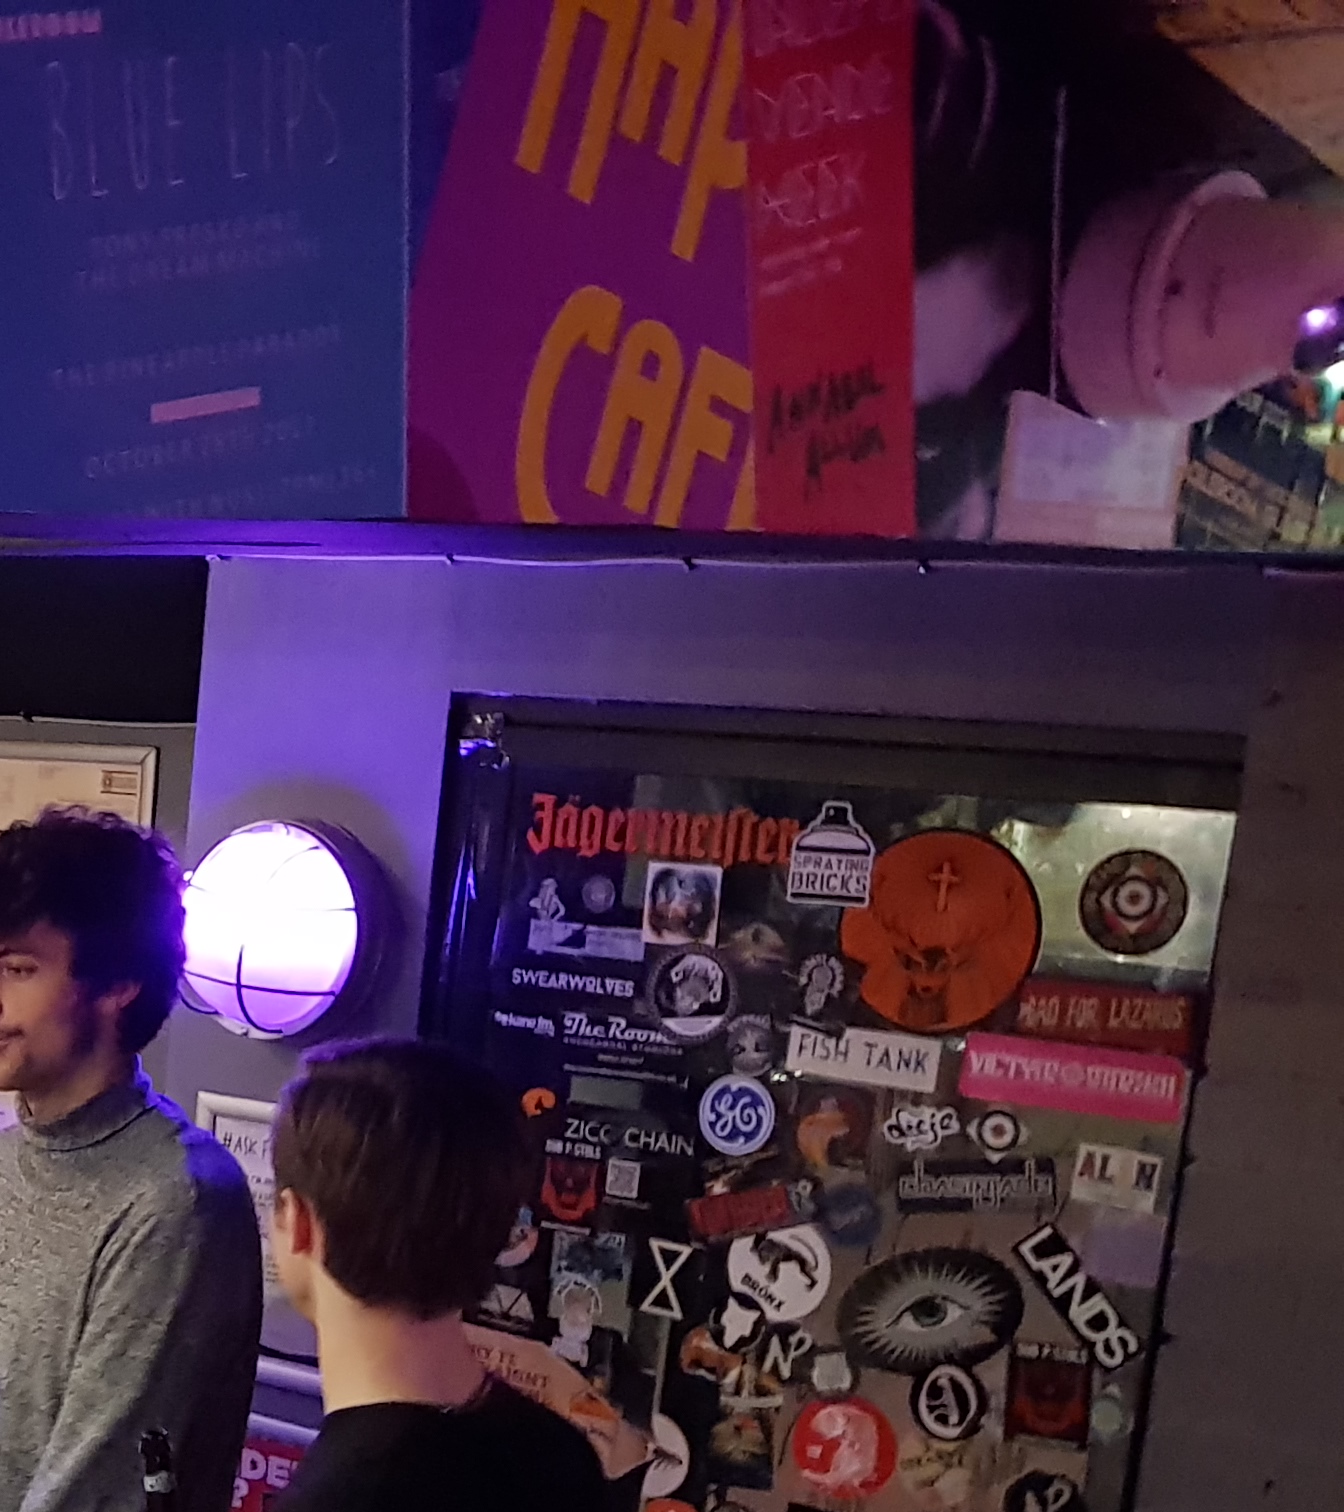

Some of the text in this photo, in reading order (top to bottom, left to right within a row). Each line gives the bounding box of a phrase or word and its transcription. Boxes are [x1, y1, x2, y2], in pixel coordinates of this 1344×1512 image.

[45, 60, 185, 202] BLUE
[791, 872, 869, 896] BRICKS
[512, 967, 635, 998] SWEARWOLVES
[798, 1033, 929, 1075] FISH TANK
[623, 1126, 695, 1157] CHAIN
[1017, 1224, 1139, 1369] LANDS
